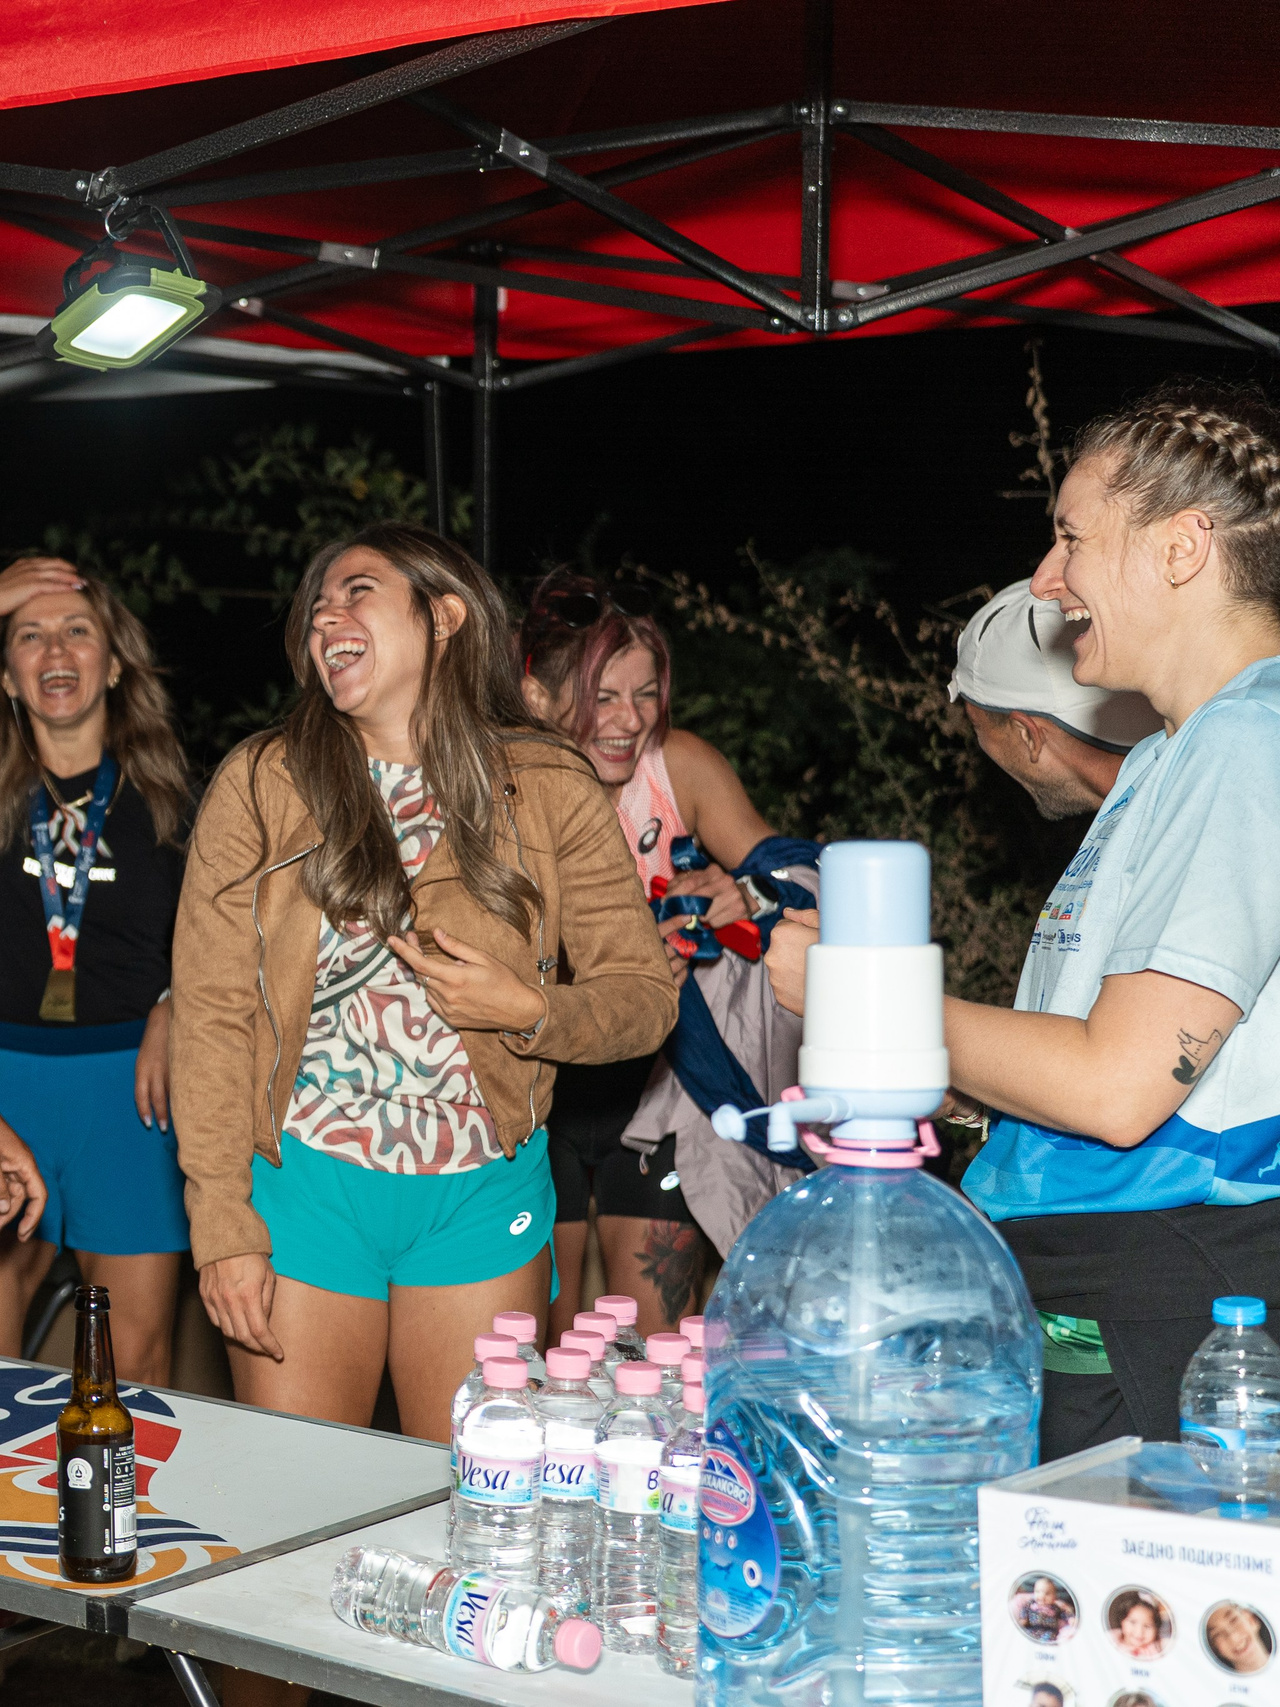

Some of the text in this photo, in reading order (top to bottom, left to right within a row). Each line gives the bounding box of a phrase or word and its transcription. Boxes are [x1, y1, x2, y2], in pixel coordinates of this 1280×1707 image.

[461, 1455, 511, 1491] Vesa
[700, 1473, 748, 1503] ИХАЛКОВО
[1121, 1538, 1174, 1561] ЗАЕДНО
[455, 1591, 490, 1647] Vesa
